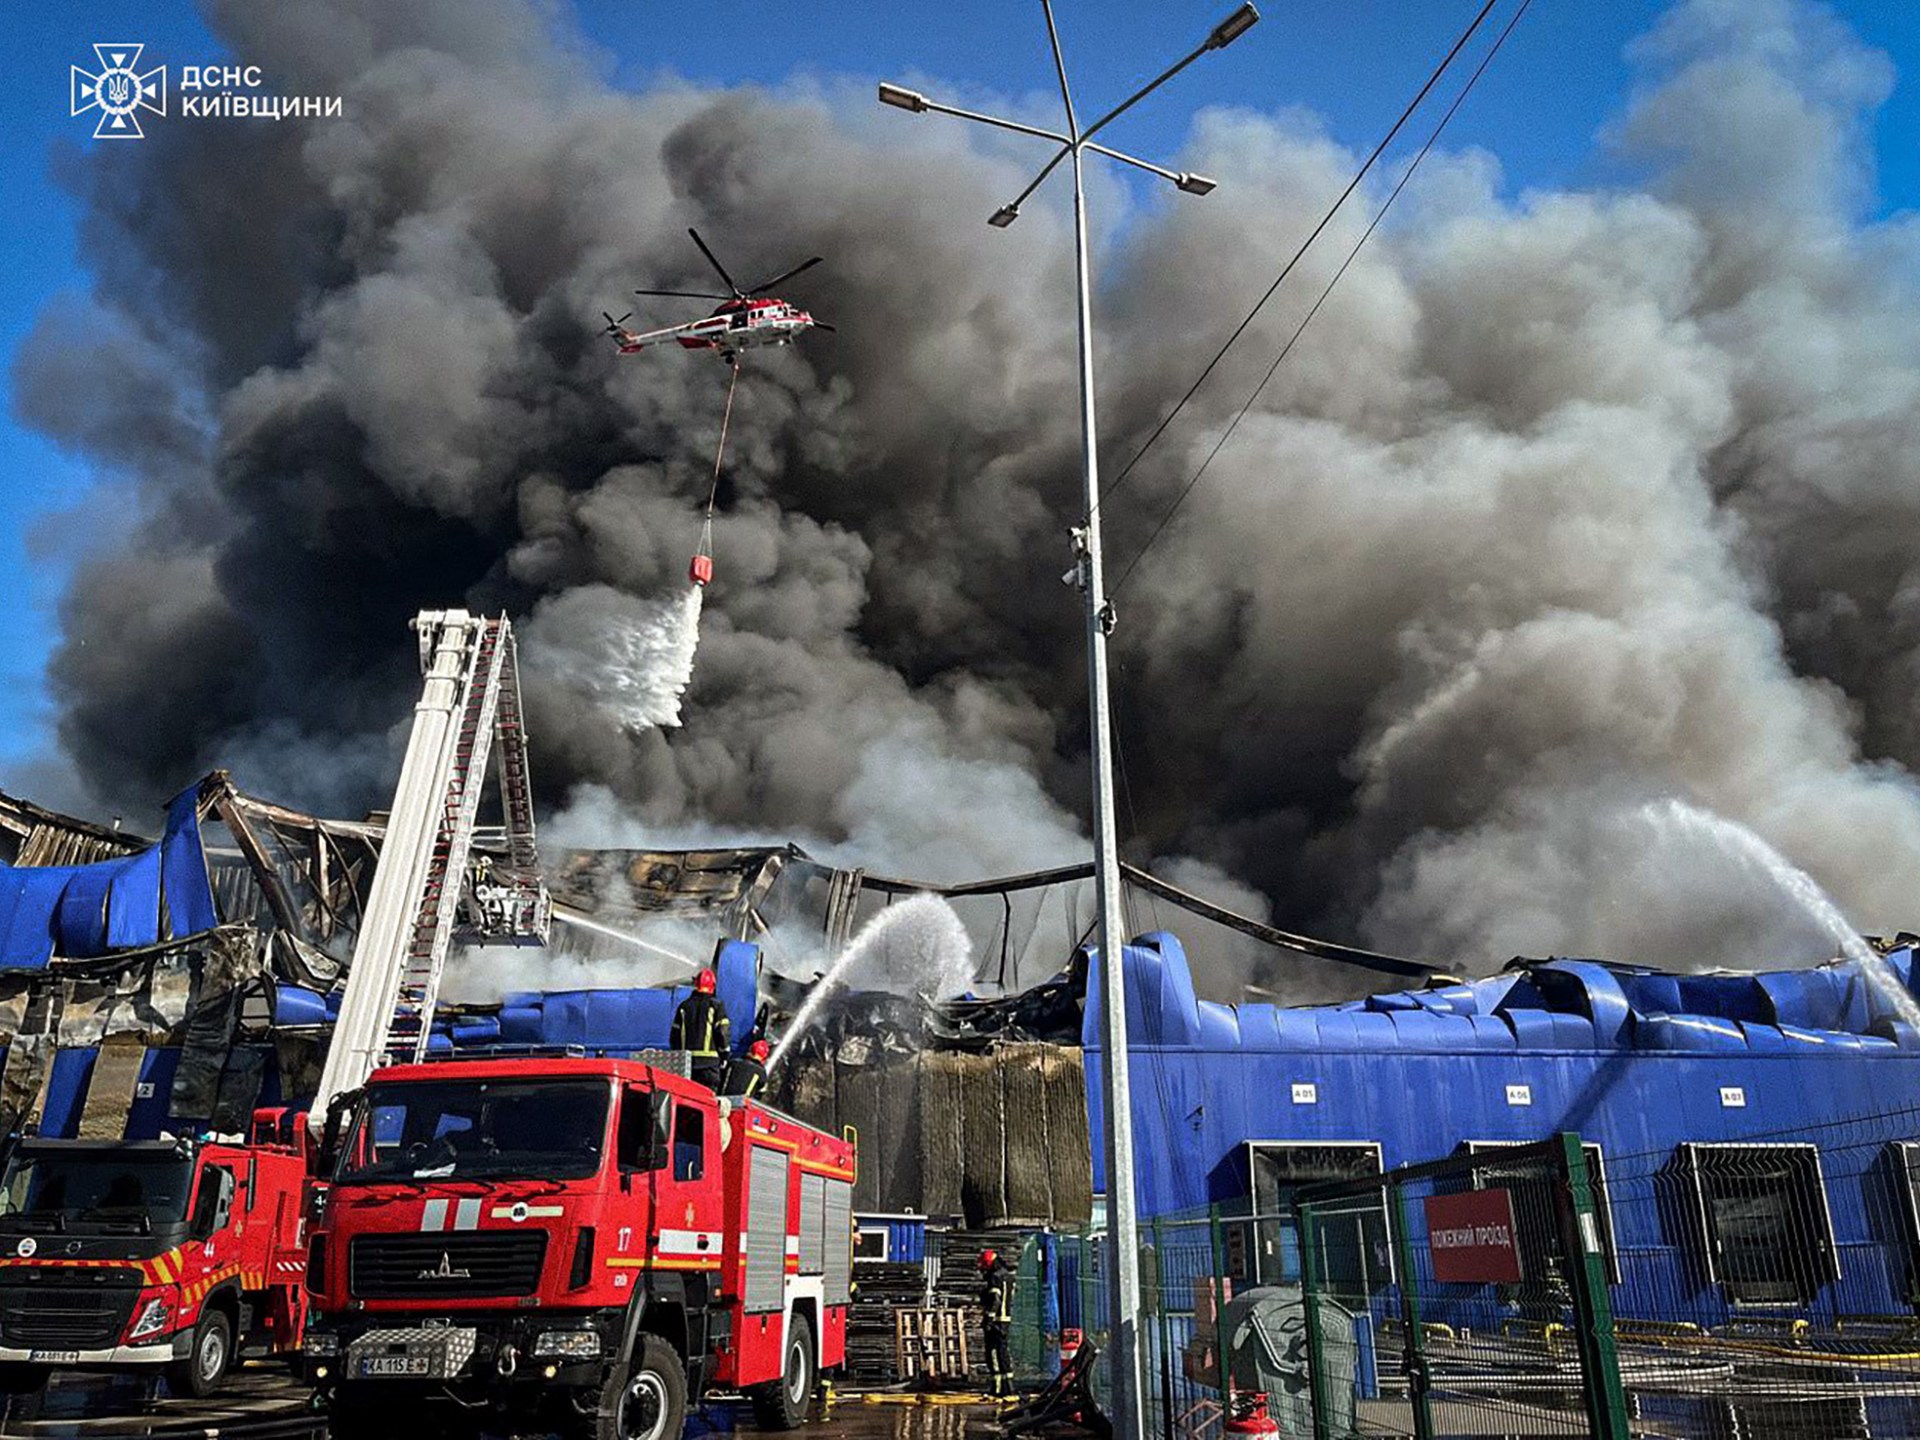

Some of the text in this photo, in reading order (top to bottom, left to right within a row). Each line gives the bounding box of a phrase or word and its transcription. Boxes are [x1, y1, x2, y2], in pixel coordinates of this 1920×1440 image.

[617, 1227, 632, 1252] 17
[1475, 1221, 1511, 1249] ПРОЇЗД
[203, 1241, 215, 1258] 44
